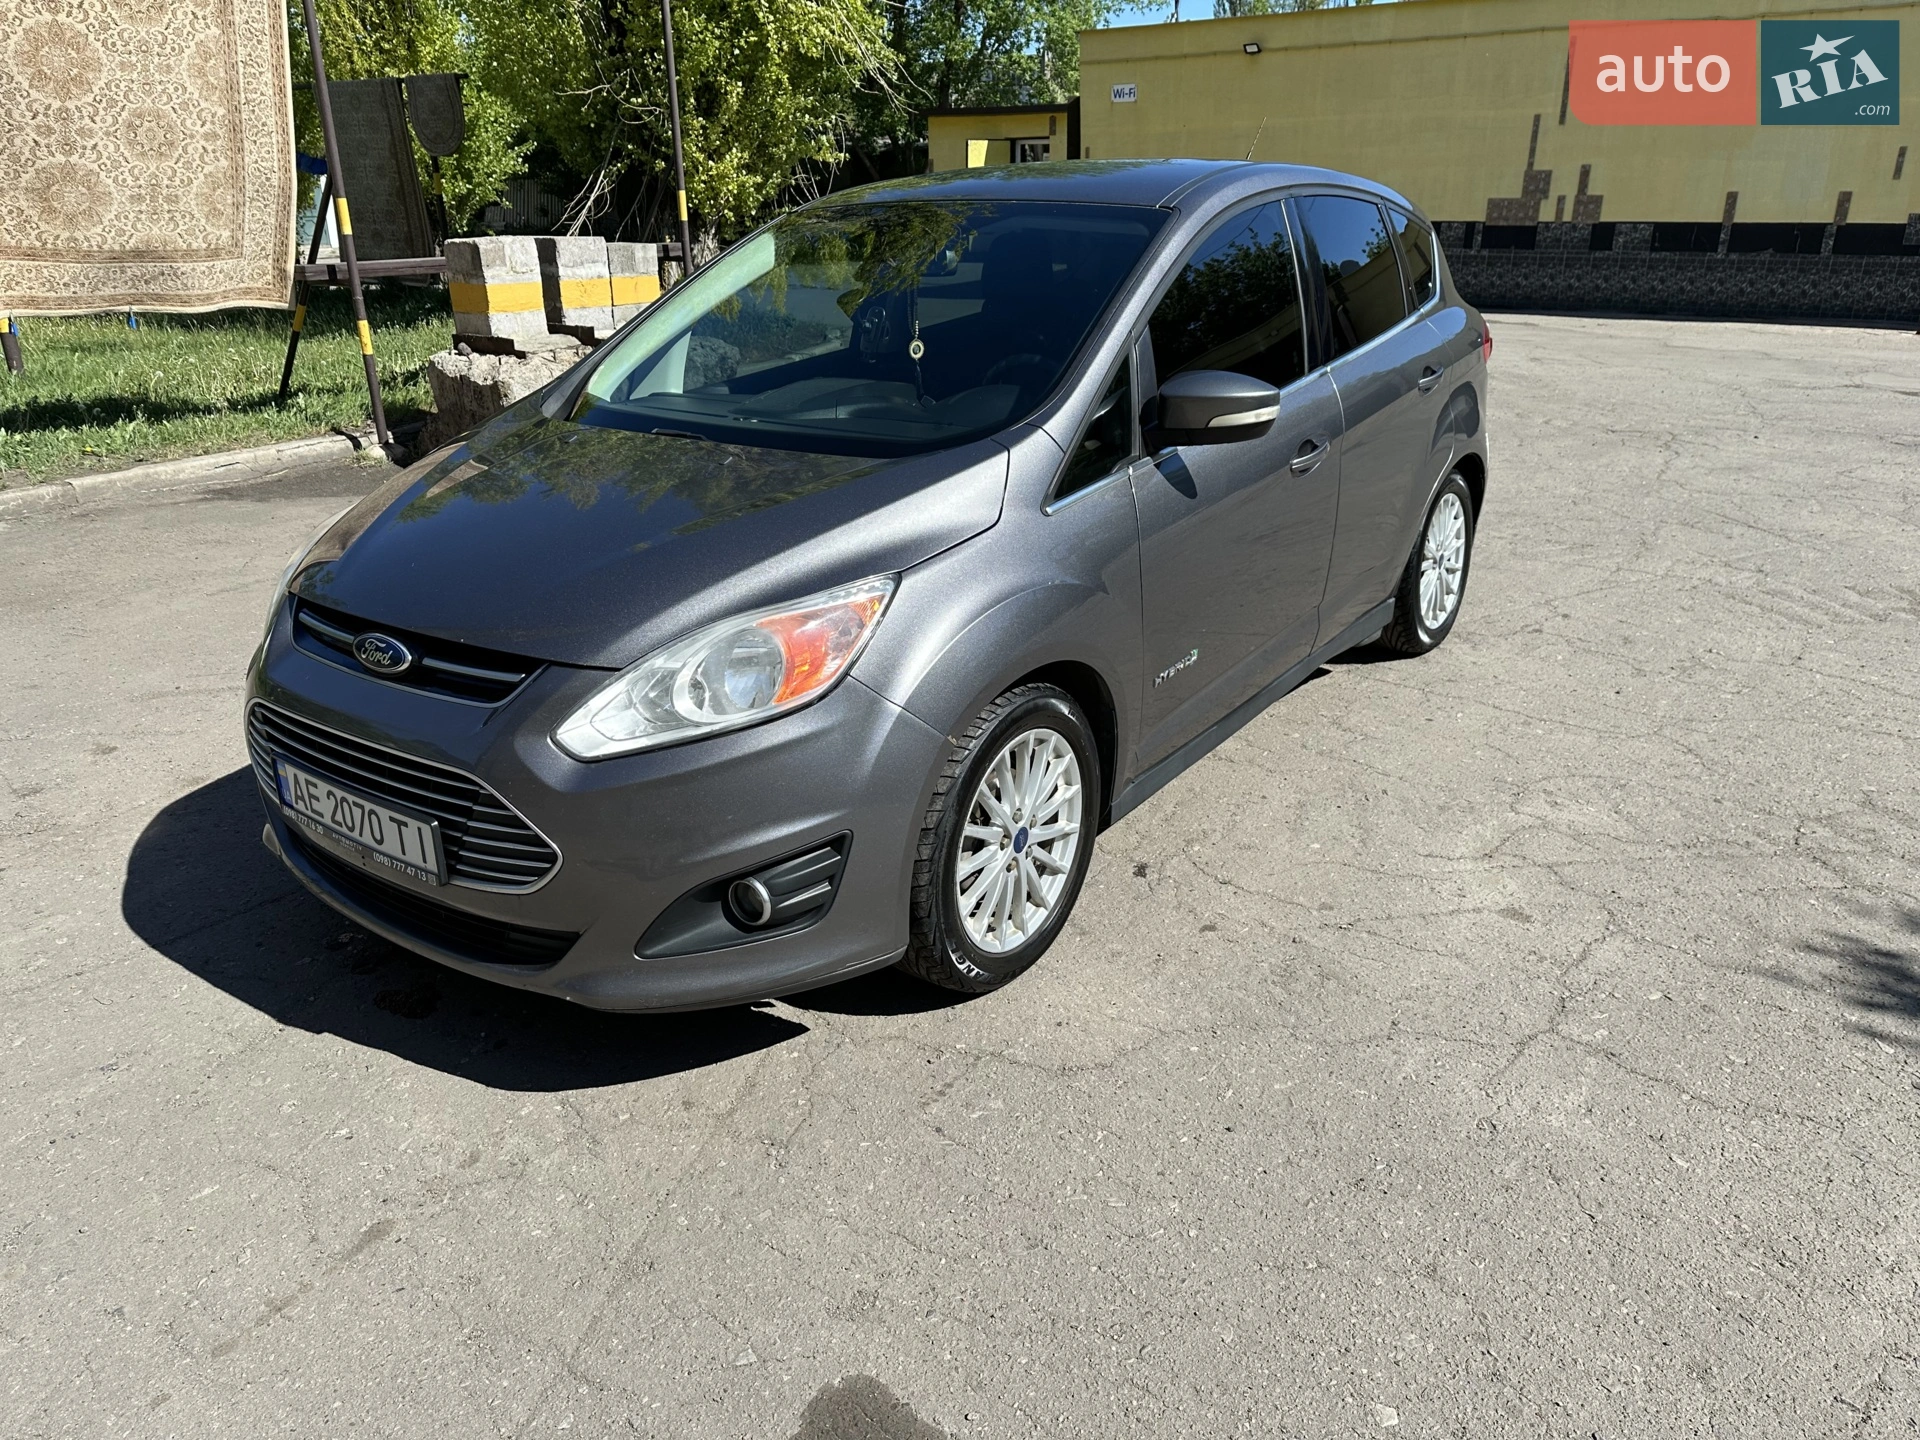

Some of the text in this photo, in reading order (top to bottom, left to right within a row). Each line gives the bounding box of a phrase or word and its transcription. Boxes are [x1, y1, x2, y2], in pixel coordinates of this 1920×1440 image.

[1112, 87, 1136, 99] Wi-Fi
[361, 639, 393, 665] Ford
[293, 772, 325, 819] AE
[326, 790, 385, 845] 2070
[373, 851, 426, 881] (098) 777 47 13
